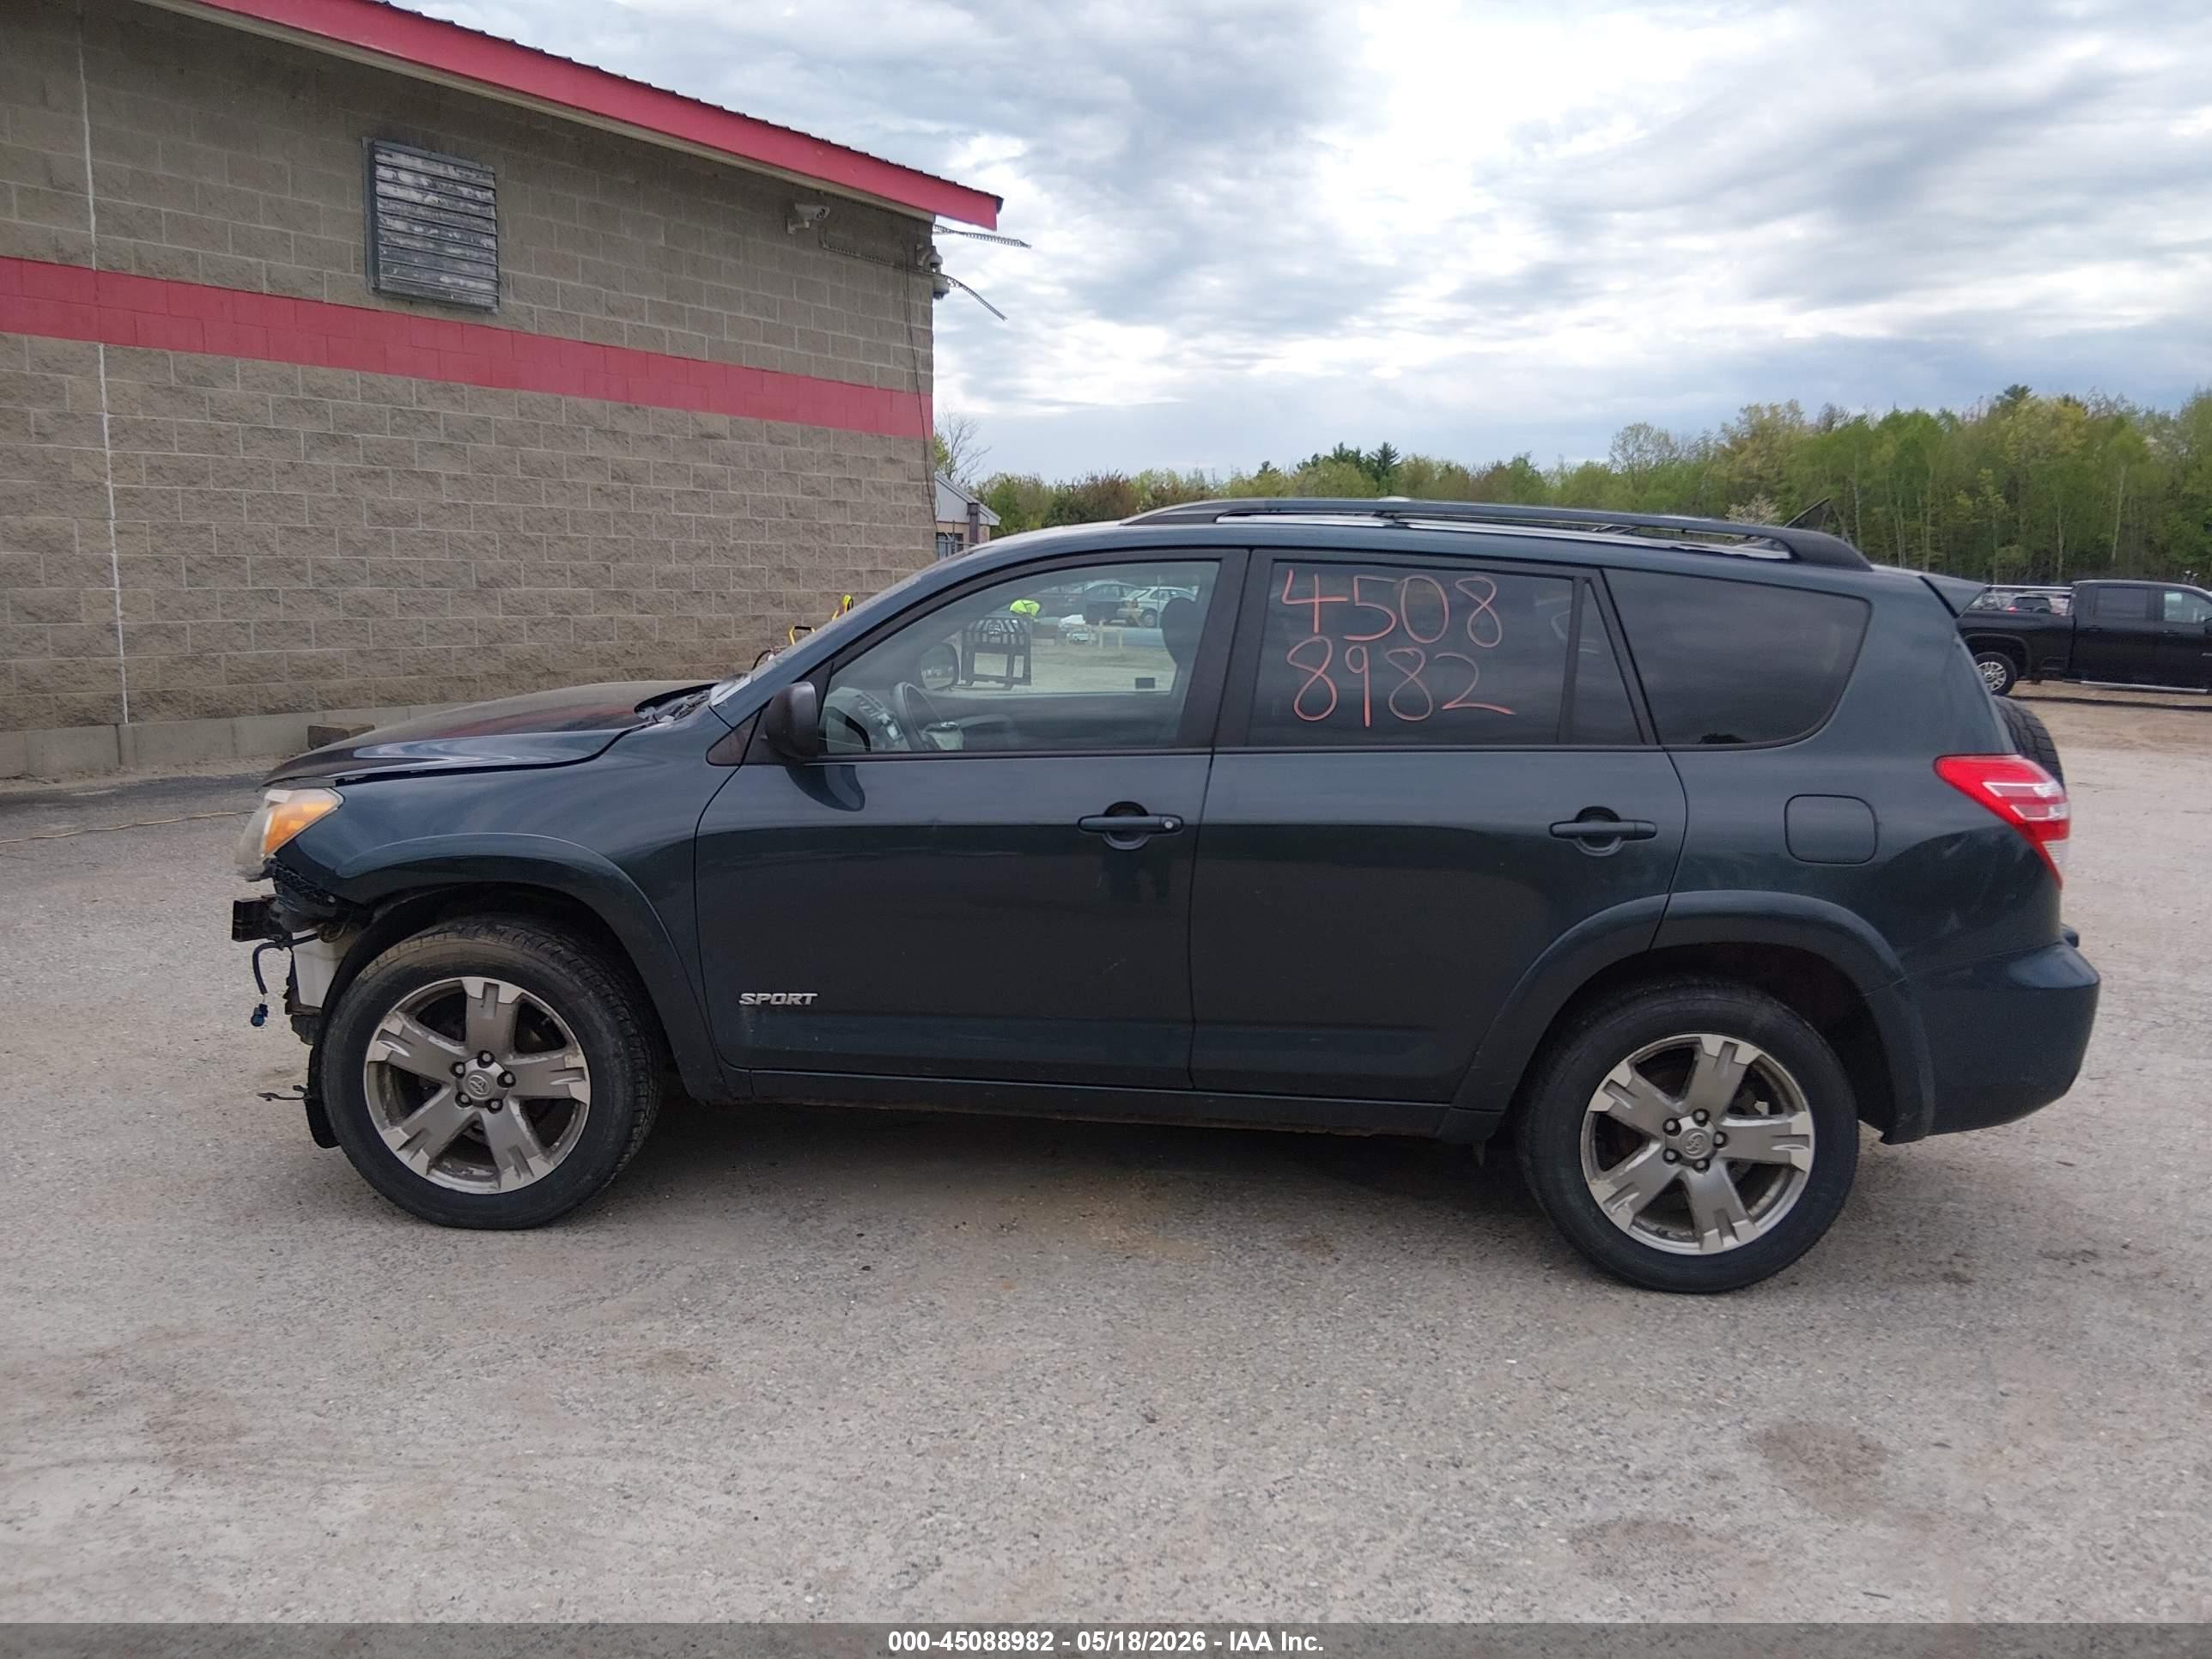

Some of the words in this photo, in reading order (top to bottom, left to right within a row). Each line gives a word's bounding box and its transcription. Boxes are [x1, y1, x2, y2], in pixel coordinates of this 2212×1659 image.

[1282, 569, 1503, 647] 4508
[1287, 635, 1516, 727] 8982
[738, 993, 818, 1006] SPORT
